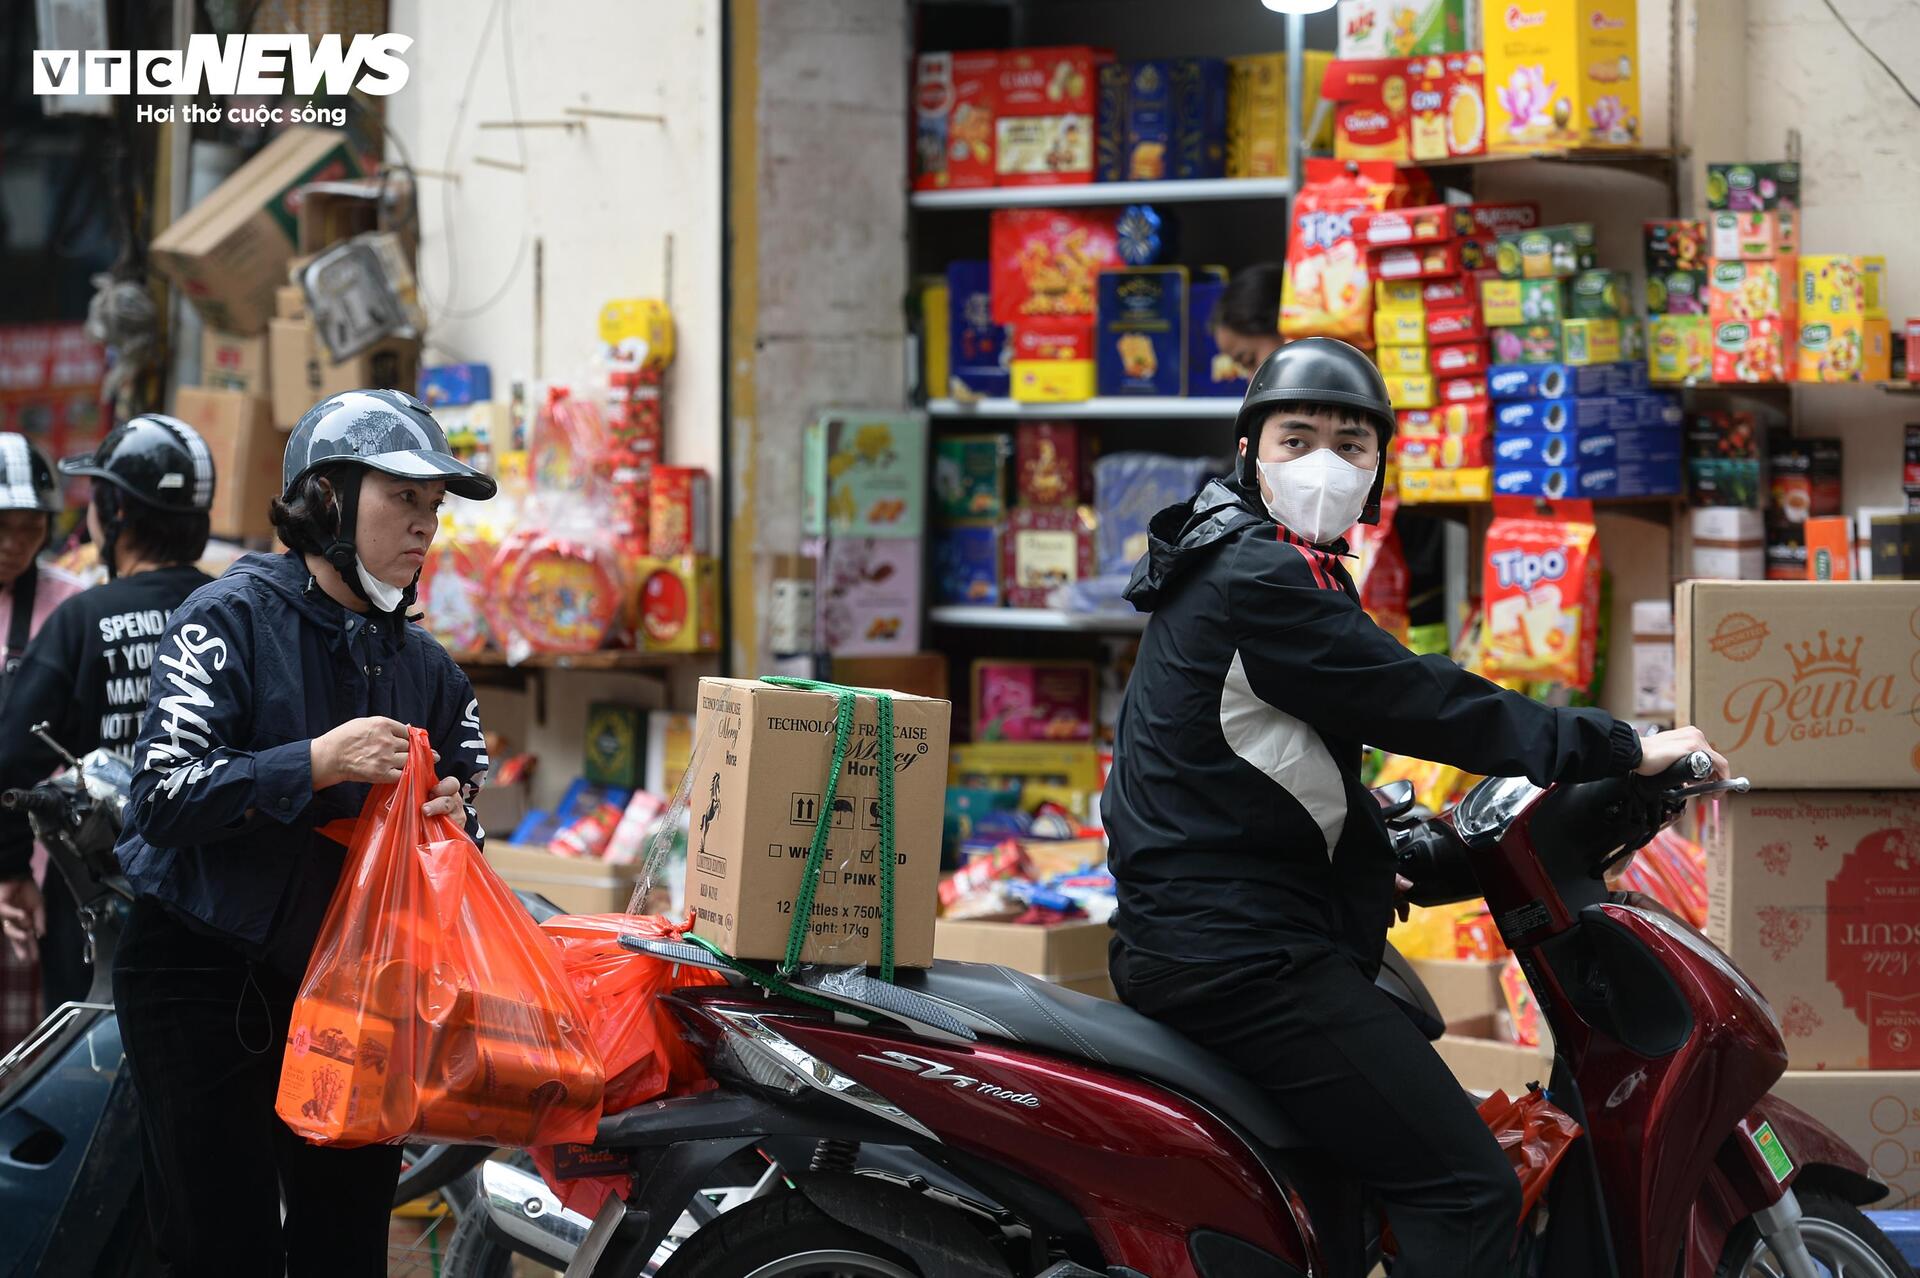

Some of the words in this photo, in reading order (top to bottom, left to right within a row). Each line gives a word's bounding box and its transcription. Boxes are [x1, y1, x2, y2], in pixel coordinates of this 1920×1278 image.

[1491, 547, 1567, 592] Tipo
[99, 609, 165, 642] SPEND
[1718, 673, 1896, 752] Reina
[858, 723, 928, 741] FRACAISE
[789, 846, 833, 861] WHE
[843, 872, 877, 886] PINK
[776, 900, 791, 914] 12
[805, 921, 839, 936] eight:
[842, 922, 869, 938] 17kg
